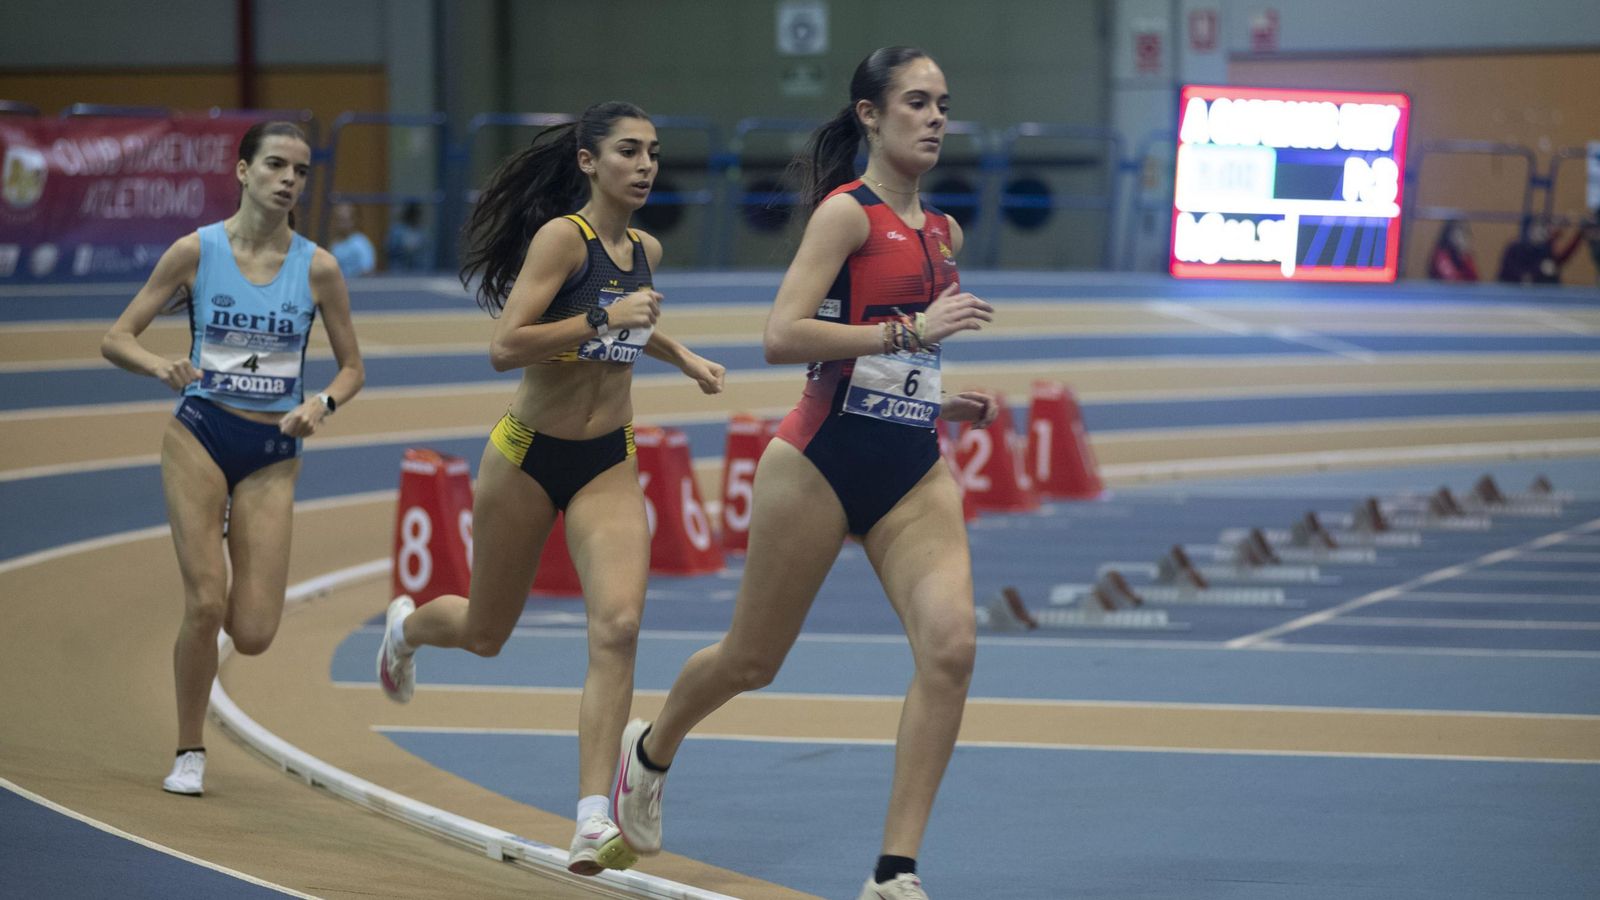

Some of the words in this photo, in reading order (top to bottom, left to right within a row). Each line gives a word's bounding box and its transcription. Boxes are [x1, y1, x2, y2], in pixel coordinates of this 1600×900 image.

[242, 353, 259, 373] 4
[903, 369, 921, 397] 6
[958, 427, 993, 491] 2
[1032, 419, 1053, 482] 1
[681, 475, 711, 551] 6
[725, 459, 756, 533] 5
[399, 506, 433, 592] 8
